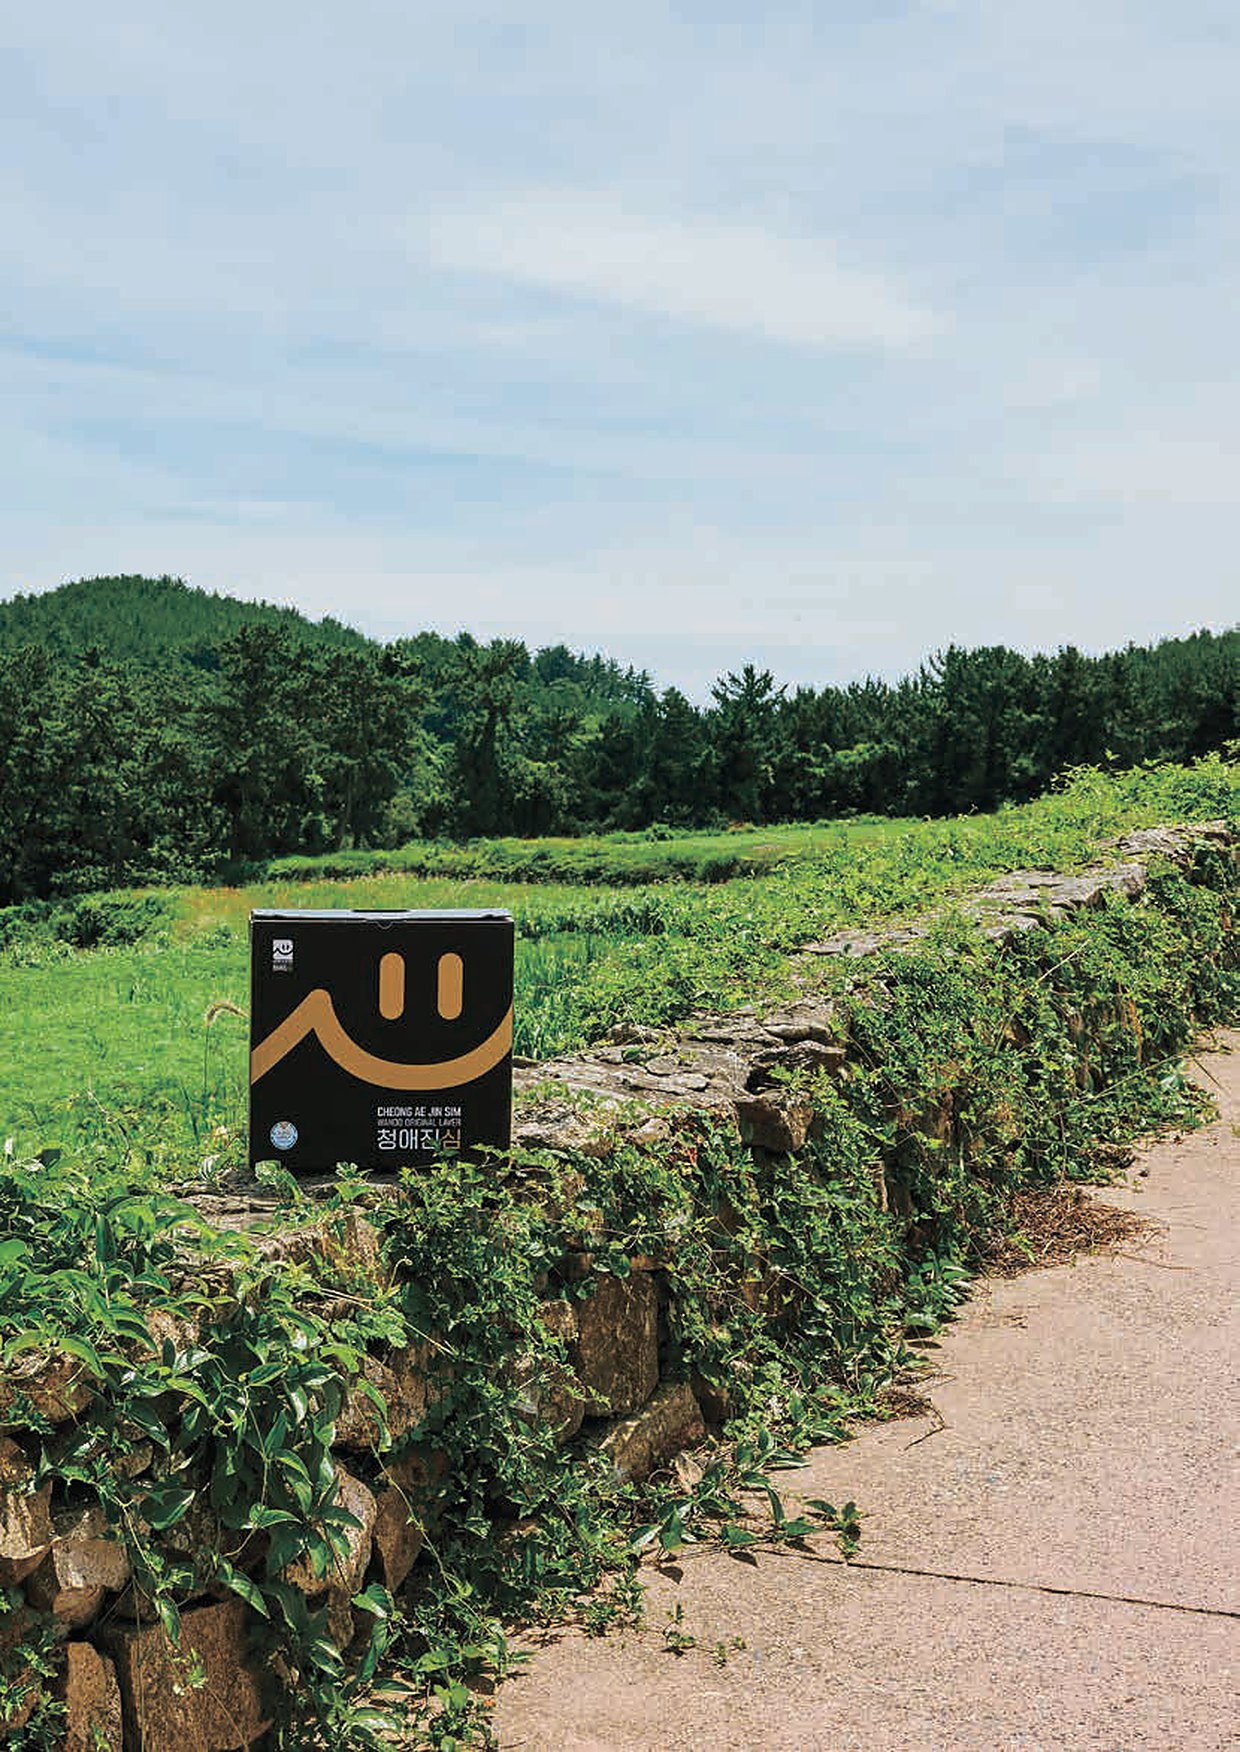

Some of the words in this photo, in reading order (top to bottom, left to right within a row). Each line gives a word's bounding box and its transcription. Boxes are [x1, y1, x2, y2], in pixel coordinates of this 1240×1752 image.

[377, 1106, 412, 1117] CHEONG
[414, 1106, 426, 1117] AE
[428, 1106, 442, 1117] JIN
[444, 1106, 461, 1117] SIM
[404, 1118, 436, 1127] ORIGINAL
[377, 1128, 461, 1150] 청애진심
